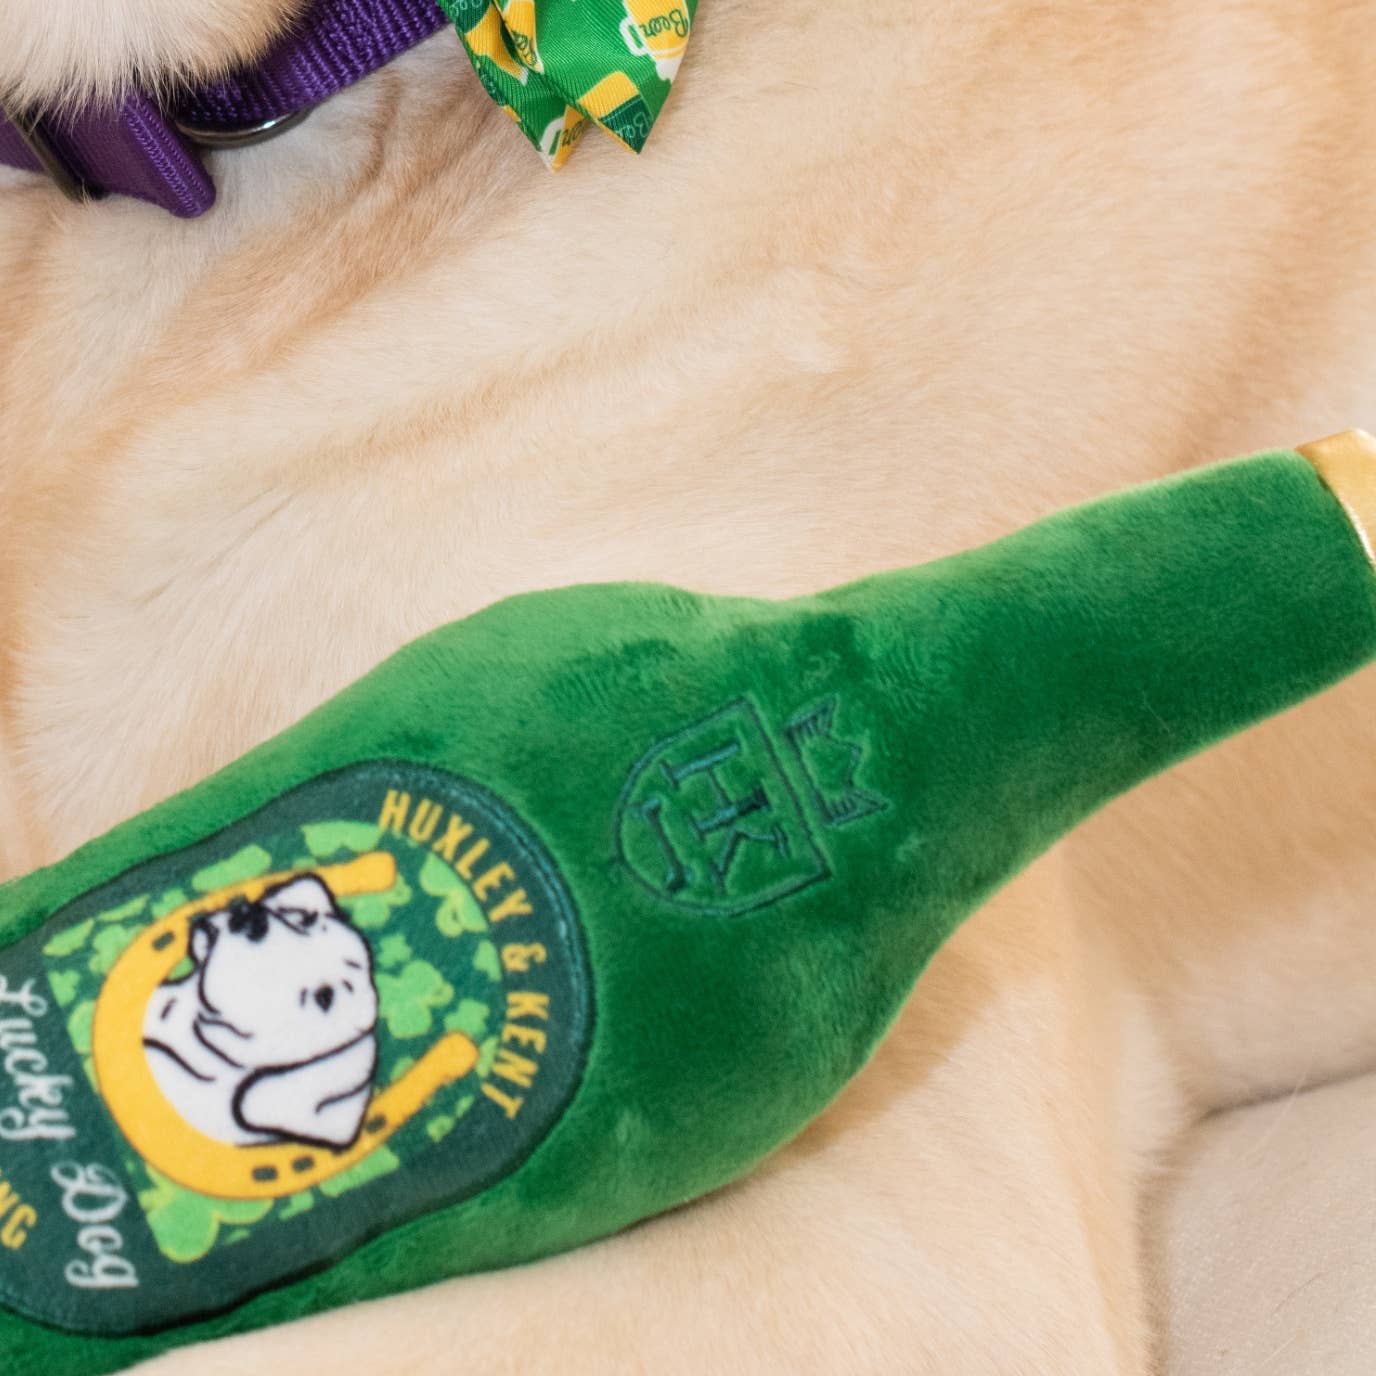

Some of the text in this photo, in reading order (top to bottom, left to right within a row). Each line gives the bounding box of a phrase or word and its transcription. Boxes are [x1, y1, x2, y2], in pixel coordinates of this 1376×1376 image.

[639, 7, 689, 38] Beer
[378, 789, 550, 1119] HUXLEY & KENT
[49, 1161, 140, 1289] Dog
